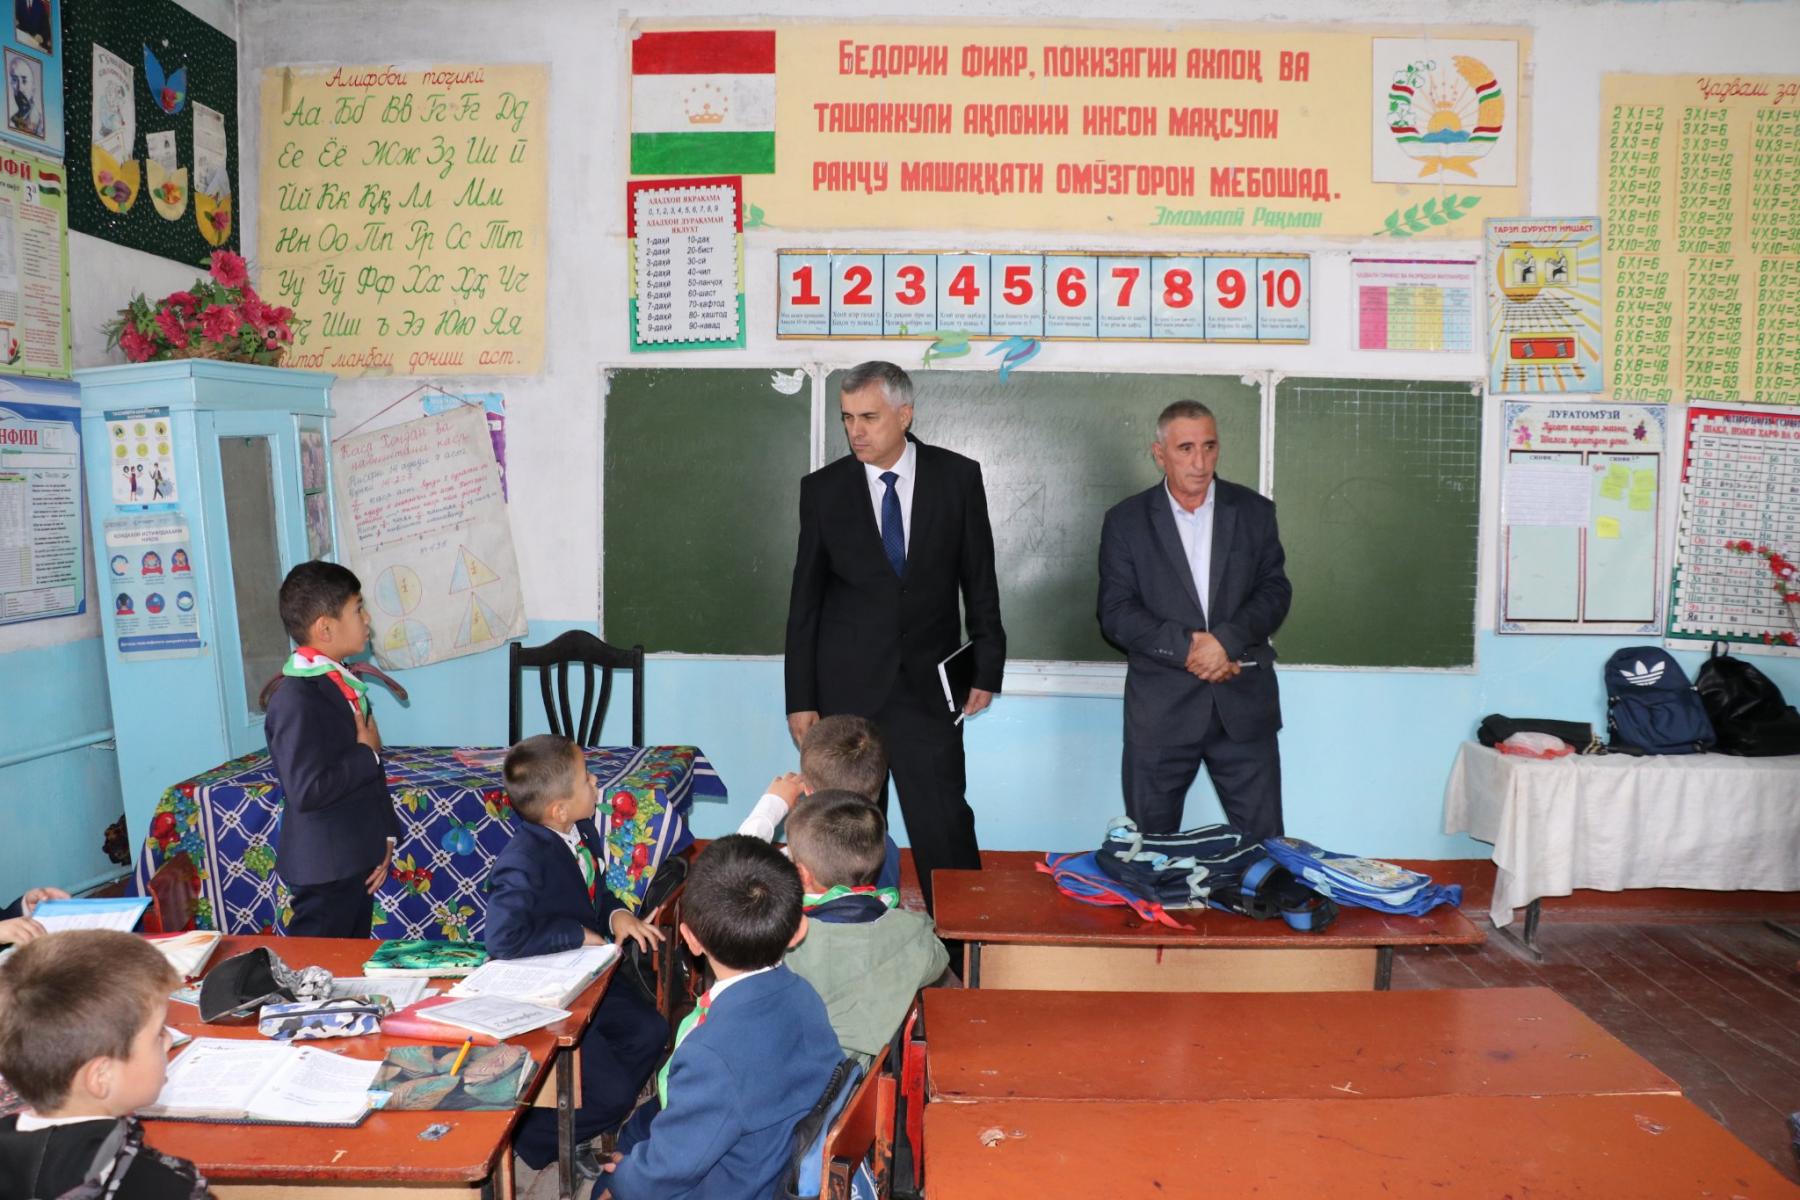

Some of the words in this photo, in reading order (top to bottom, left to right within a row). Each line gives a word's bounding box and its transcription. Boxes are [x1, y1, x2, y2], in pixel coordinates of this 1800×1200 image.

[838, 40, 948, 78] БЕДОРИИ
[962, 44, 1036, 80] ФИКР,
[1044, 46, 1176, 78] ПОКИЗАГИИ
[1187, 48, 1262, 83] АХЛОҚ
[1279, 50, 1310, 82] ВА
[284, 96, 320, 126] Аа
[334, 95, 376, 125] Бб
[382, 92, 413, 123] Вв
[814, 103, 952, 134] ТАШАККУЛИ
[963, 104, 1068, 138] АҚЛОНИИ
[1083, 105, 1157, 137] ИНСОН
[278, 142, 304, 168] Ее
[318, 137, 347, 167] Ёё
[316, 184, 350, 210] Кк
[399, 182, 434, 208] Лл
[453, 177, 504, 206] Мм
[813, 161, 888, 194] РАНҶУ
[900, 161, 1042, 196] МАШАҚҚАТИ
[1210, 166, 1341, 202] МЕБОШАД.
[275, 227, 312, 253] Нн
[318, 224, 348, 252] Оо
[356, 222, 394, 250] Пп
[406, 220, 434, 260] Рр
[446, 223, 472, 250] Сс
[480, 220, 522, 249] Тт
[357, 265, 395, 304] Фф
[402, 264, 445, 294] Хх
[792, 267, 819, 304] 1
[844, 266, 872, 304] 2
[897, 266, 925, 304] 3
[949, 266, 979, 304] 4
[1004, 266, 1032, 304] 5
[1058, 268, 1086, 307] 6
[1113, 268, 1139, 306] 7
[1165, 269, 1193, 307] 8
[1218, 269, 1245, 308] 9
[1264, 270, 1301, 307] 10
[322, 312, 361, 337] Шш
[483, 306, 522, 336] Яя
